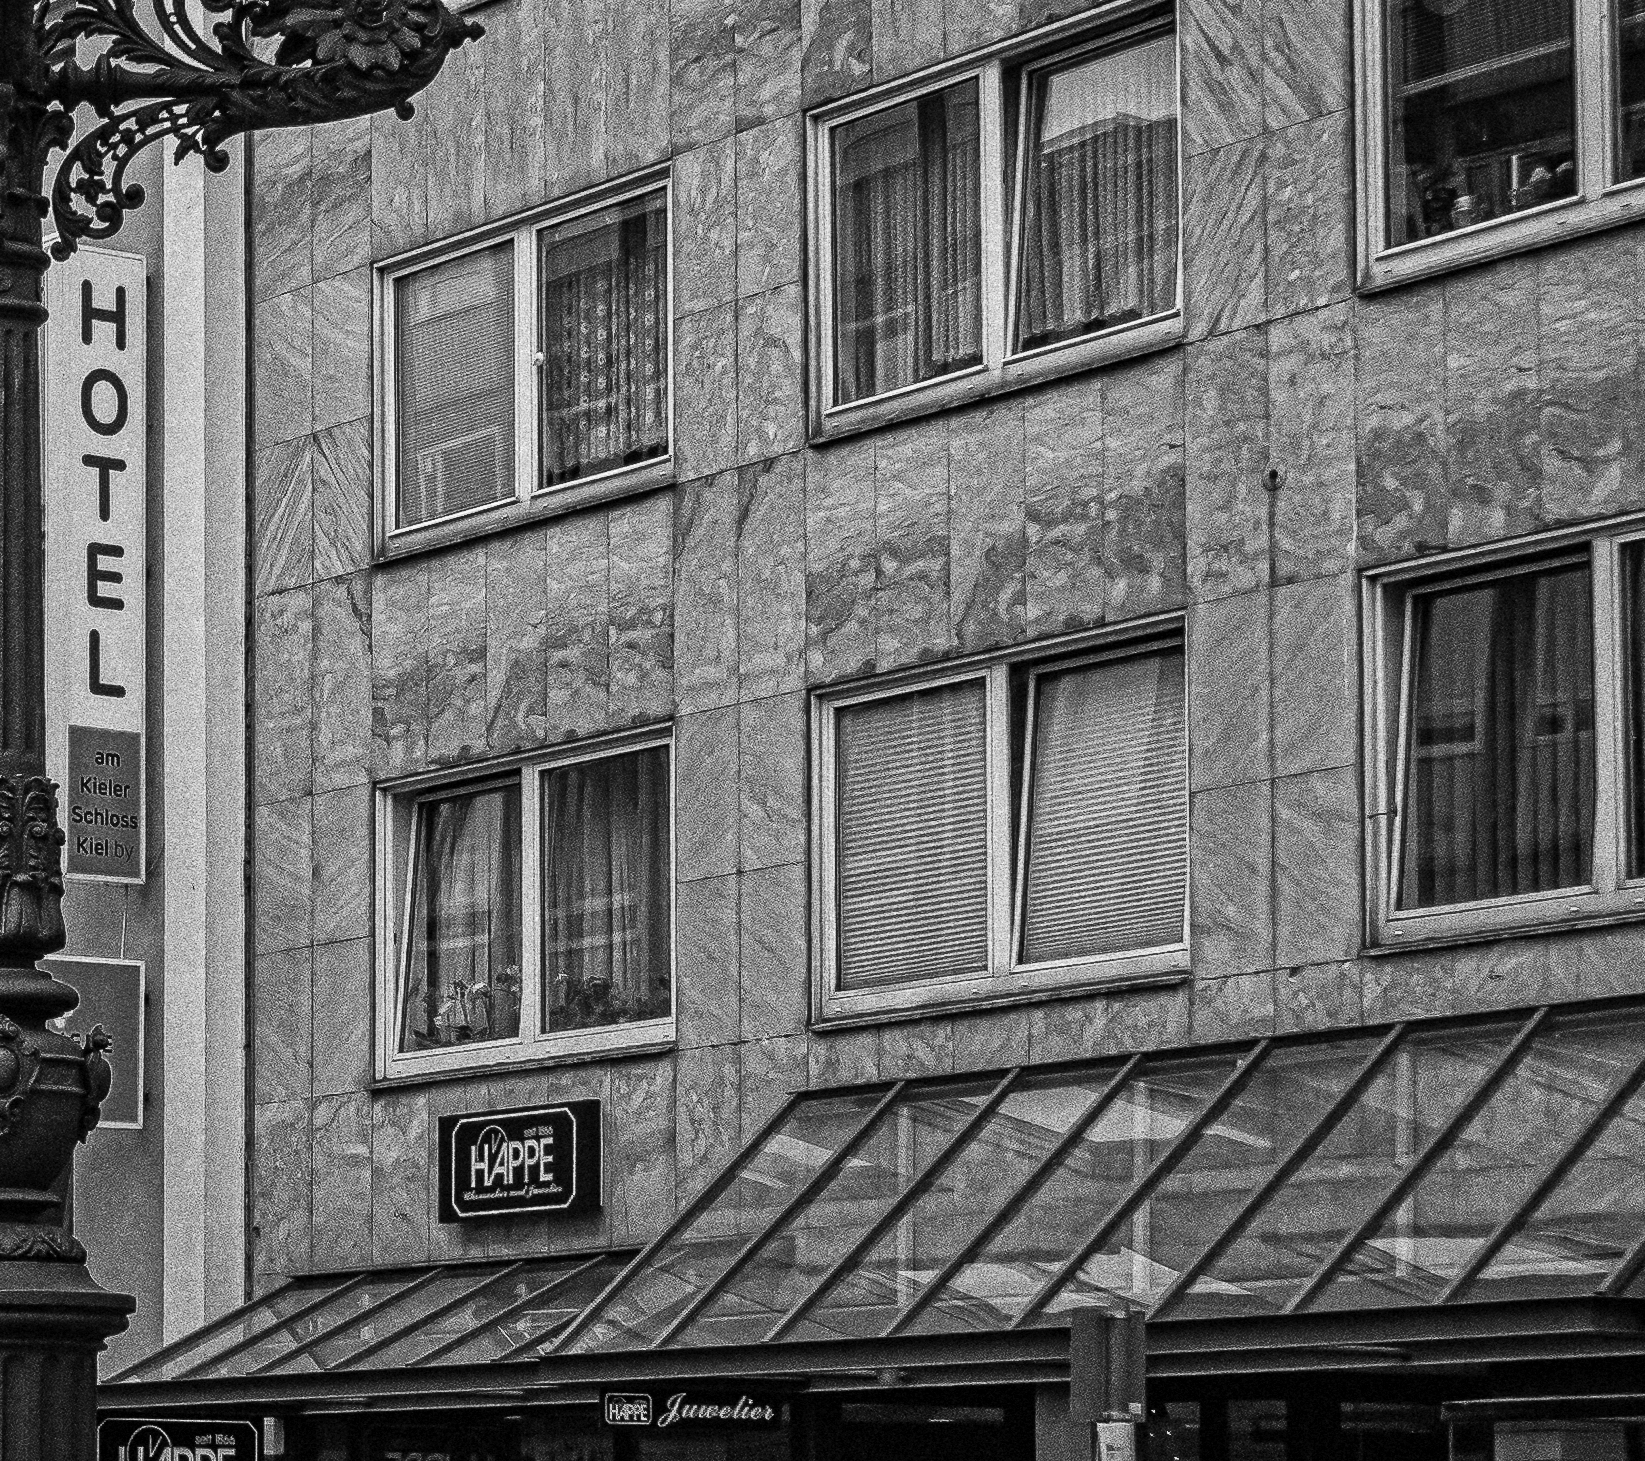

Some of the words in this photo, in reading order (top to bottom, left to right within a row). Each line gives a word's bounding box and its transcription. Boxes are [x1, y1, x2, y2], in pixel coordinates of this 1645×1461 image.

[80, 279, 129, 699] HOTEL
[94, 751, 121, 767] am
[80, 776, 131, 798] Kieler
[71, 805, 139, 829] Schloss
[76, 836, 109, 857] Kiel
[114, 839, 134, 862] by
[470, 1137, 554, 1188] HAPPE
[609, 1403, 648, 1421] HAPPE
[657, 1392, 775, 1428] Juwelier
[194, 1433, 213, 1445] seit
[214, 1433, 236, 1446] 1866
